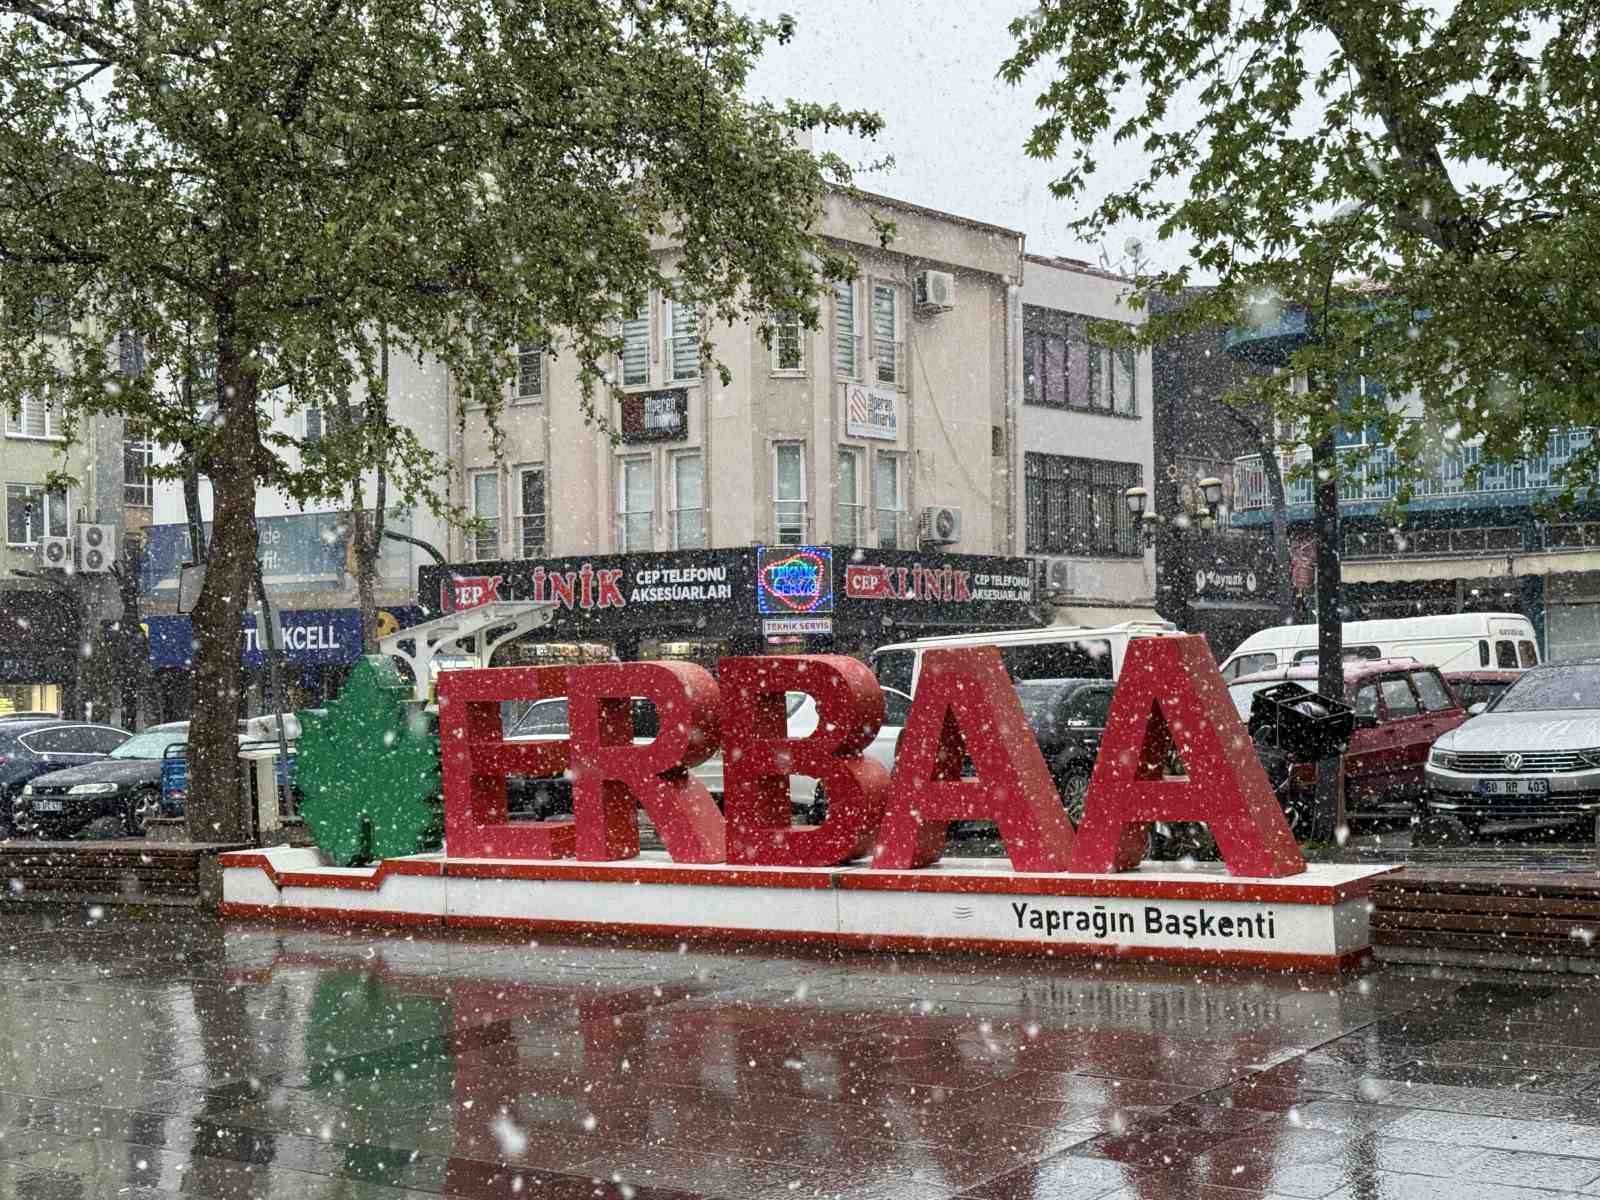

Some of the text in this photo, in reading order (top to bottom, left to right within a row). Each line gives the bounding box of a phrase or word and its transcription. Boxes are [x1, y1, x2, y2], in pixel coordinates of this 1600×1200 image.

[636, 567, 726, 585] CEP TELEFONU
[852, 563, 973, 602] CEP KLİNİK
[974, 574, 1030, 587] CEP TELEFONU
[630, 585, 732, 602] AKSESUARLARI
[437, 633, 1307, 878] ERBAA
[1012, 903, 1276, 940] Yaprağın Başkenti
